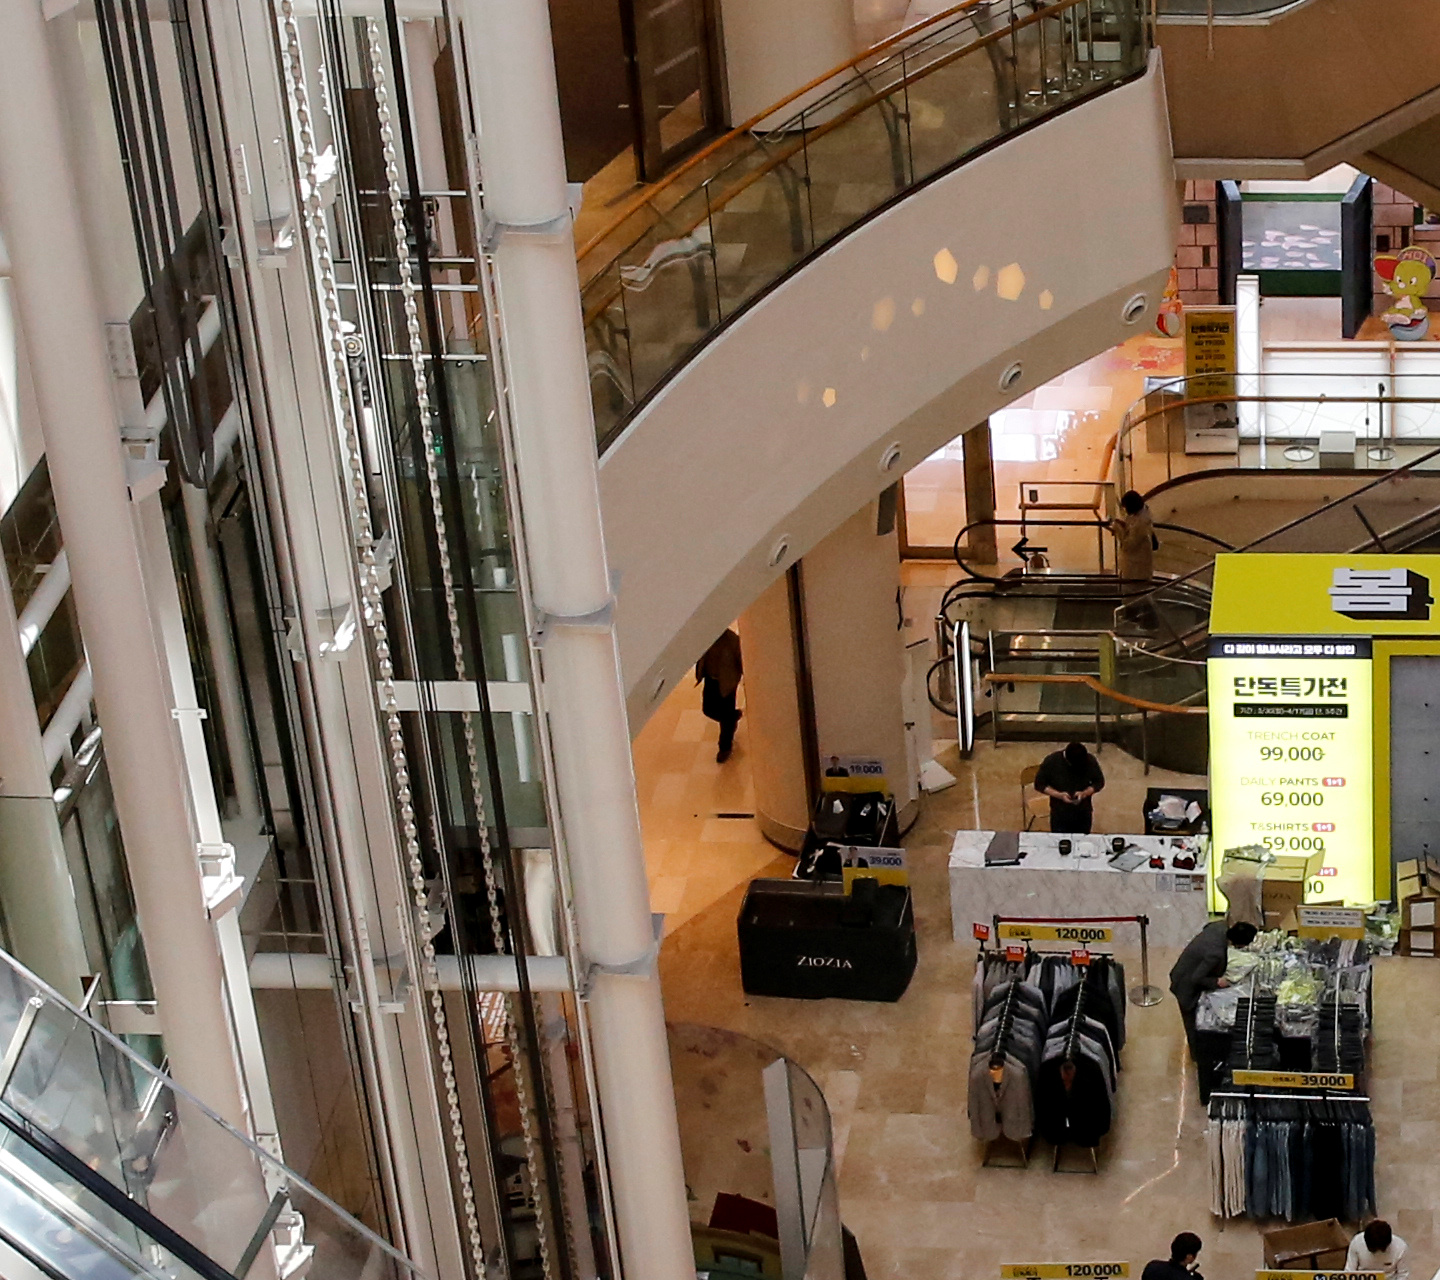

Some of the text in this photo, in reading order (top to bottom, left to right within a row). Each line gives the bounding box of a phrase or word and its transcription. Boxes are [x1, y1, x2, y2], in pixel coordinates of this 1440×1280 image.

[1328, 568, 1416, 613] 봄
[1233, 677, 1348, 698] 단독특가전
[1247, 731, 1336, 741] TRENCH COAT
[1240, 777, 1277, 786] DAILY
[1279, 777, 1319, 786] PANTS
[1261, 792, 1324, 808] 69,000
[1262, 836, 1325, 851] 59,000
[1055, 928, 1106, 940] 120,000
[797, 956, 853, 969] ZIOZIA
[1301, 1075, 1347, 1086] 39,000
[1065, 1264, 1122, 1276] 120,000
